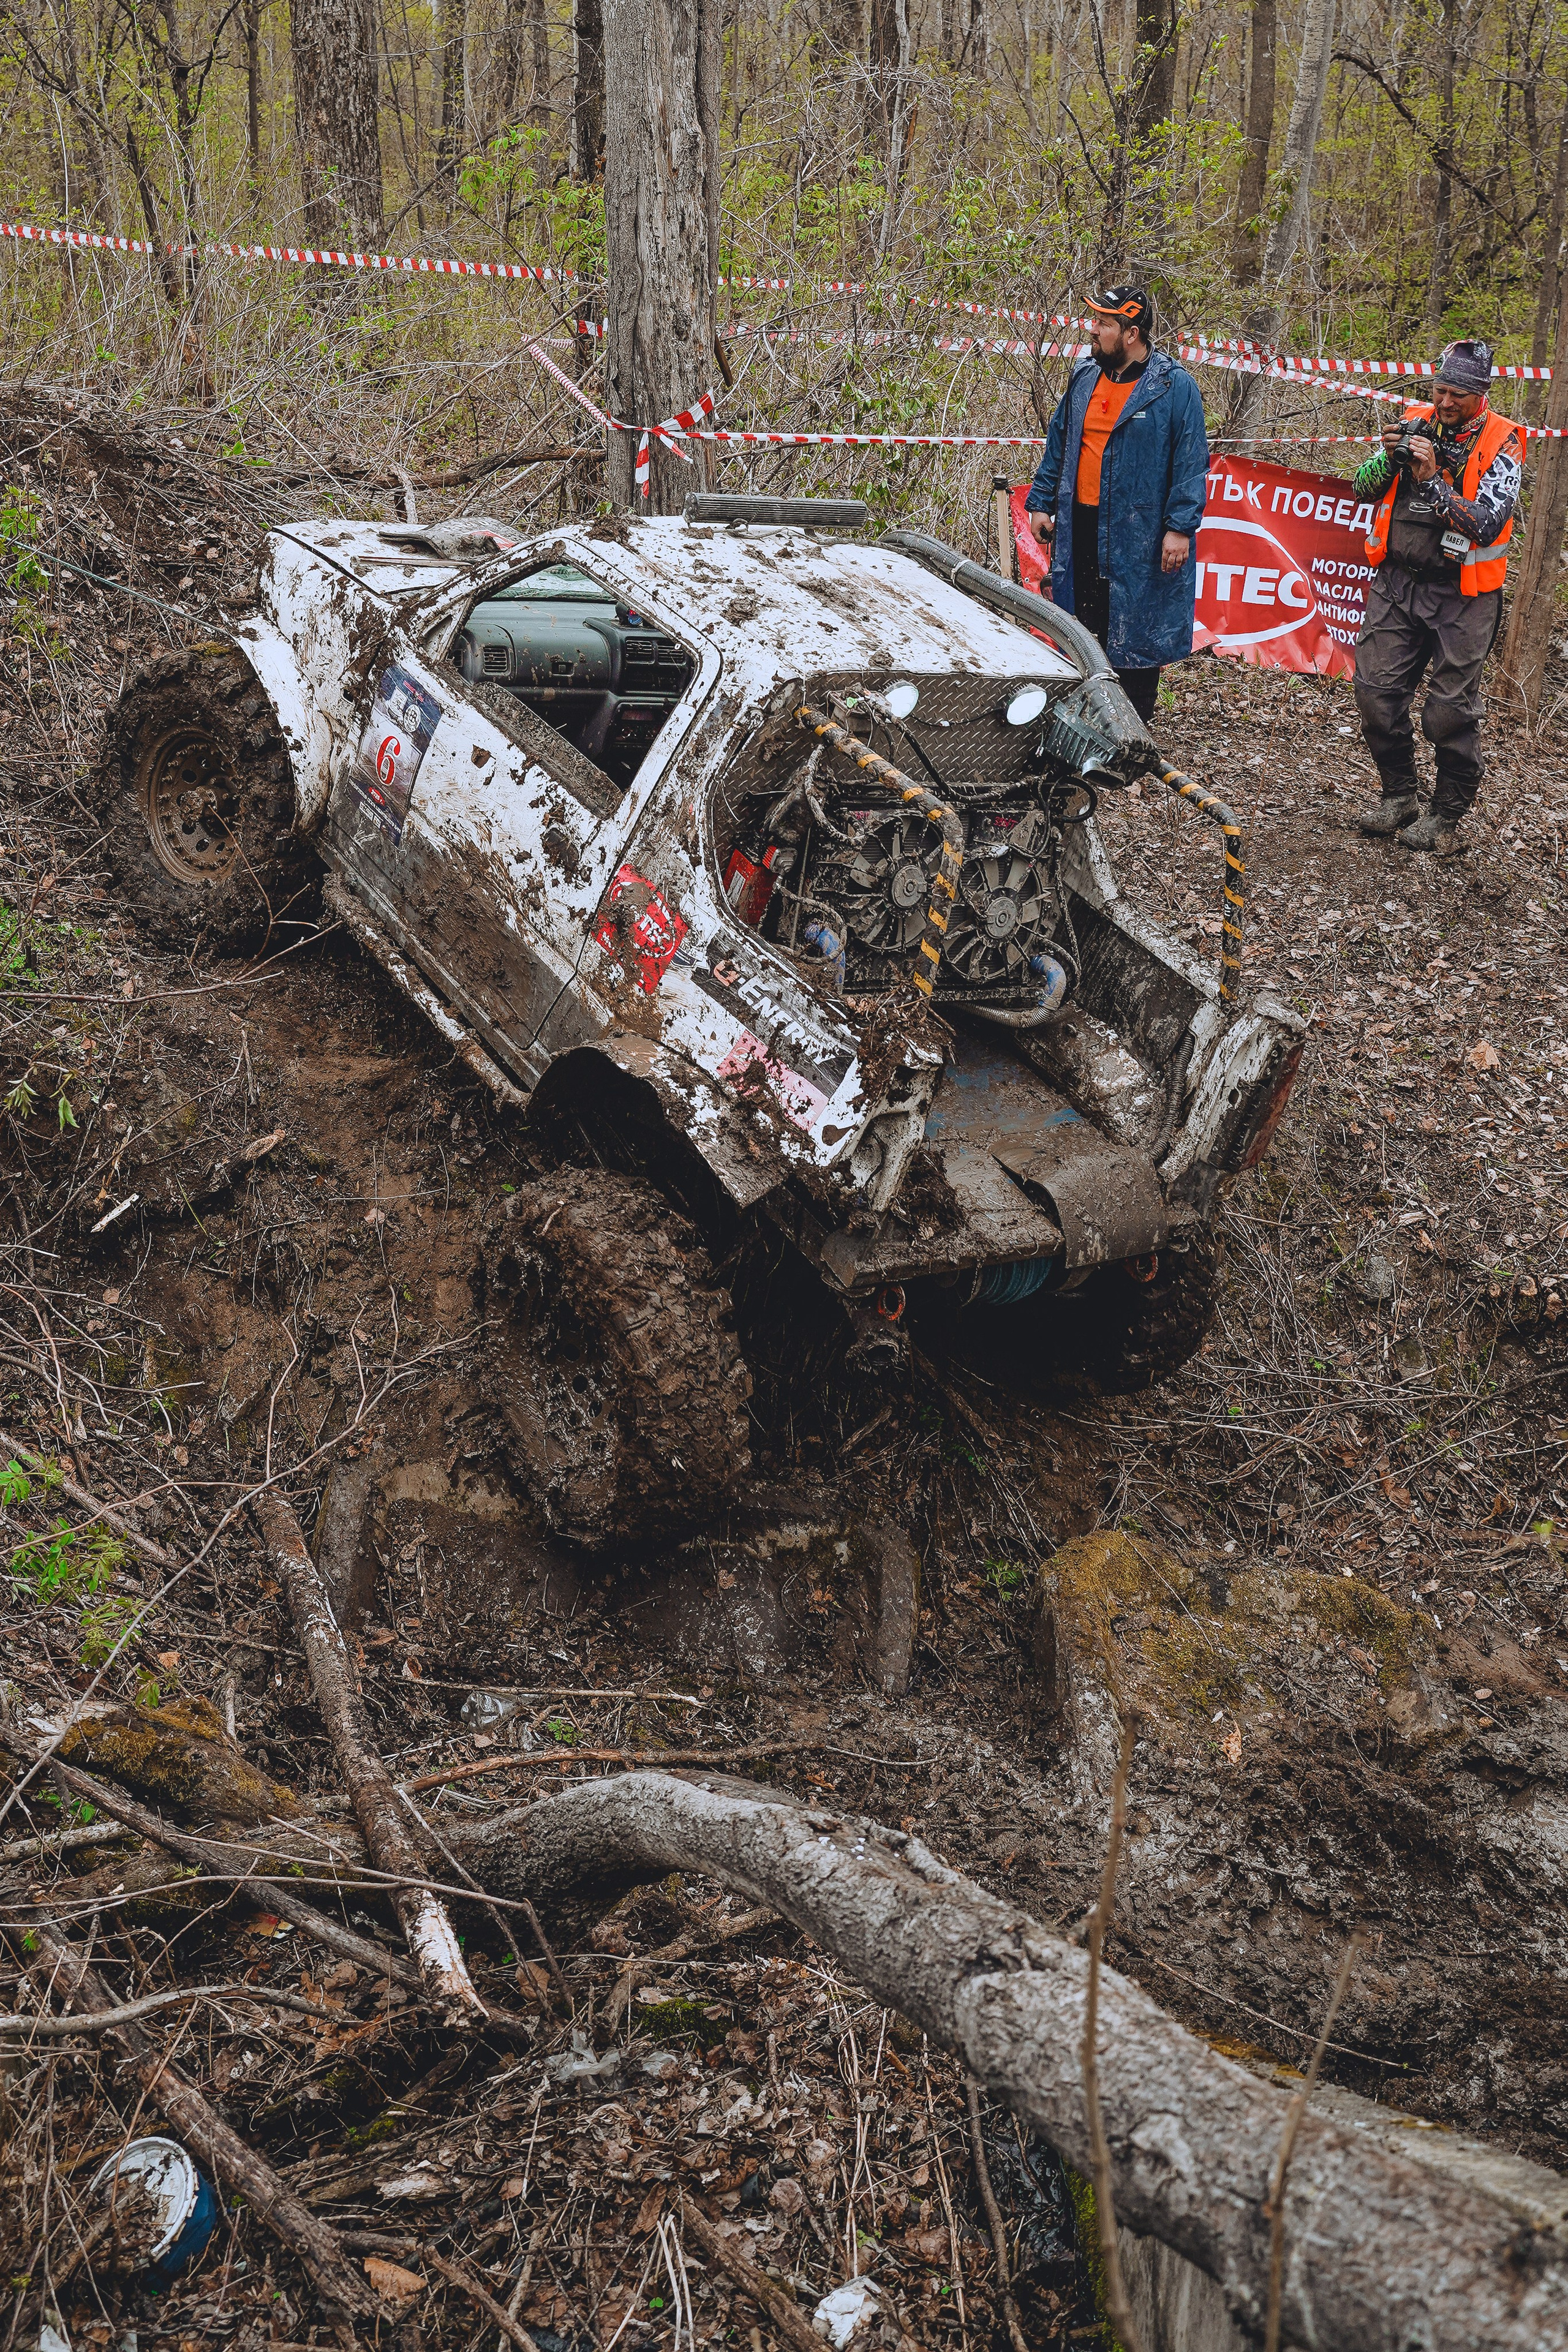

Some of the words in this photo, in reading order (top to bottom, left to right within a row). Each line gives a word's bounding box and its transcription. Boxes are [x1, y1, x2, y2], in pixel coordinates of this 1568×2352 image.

[1466, 435, 1477, 450] Nikon
[1206, 473, 1244, 502] ТЬ
[1271, 486, 1375, 535] ПОБЕД
[1446, 535, 1464, 546] ПАВЕЛ
[1311, 557, 1378, 581] МОТОРН
[1317, 600, 1366, 625] АНТИФР
[375, 736, 401, 786] 6
